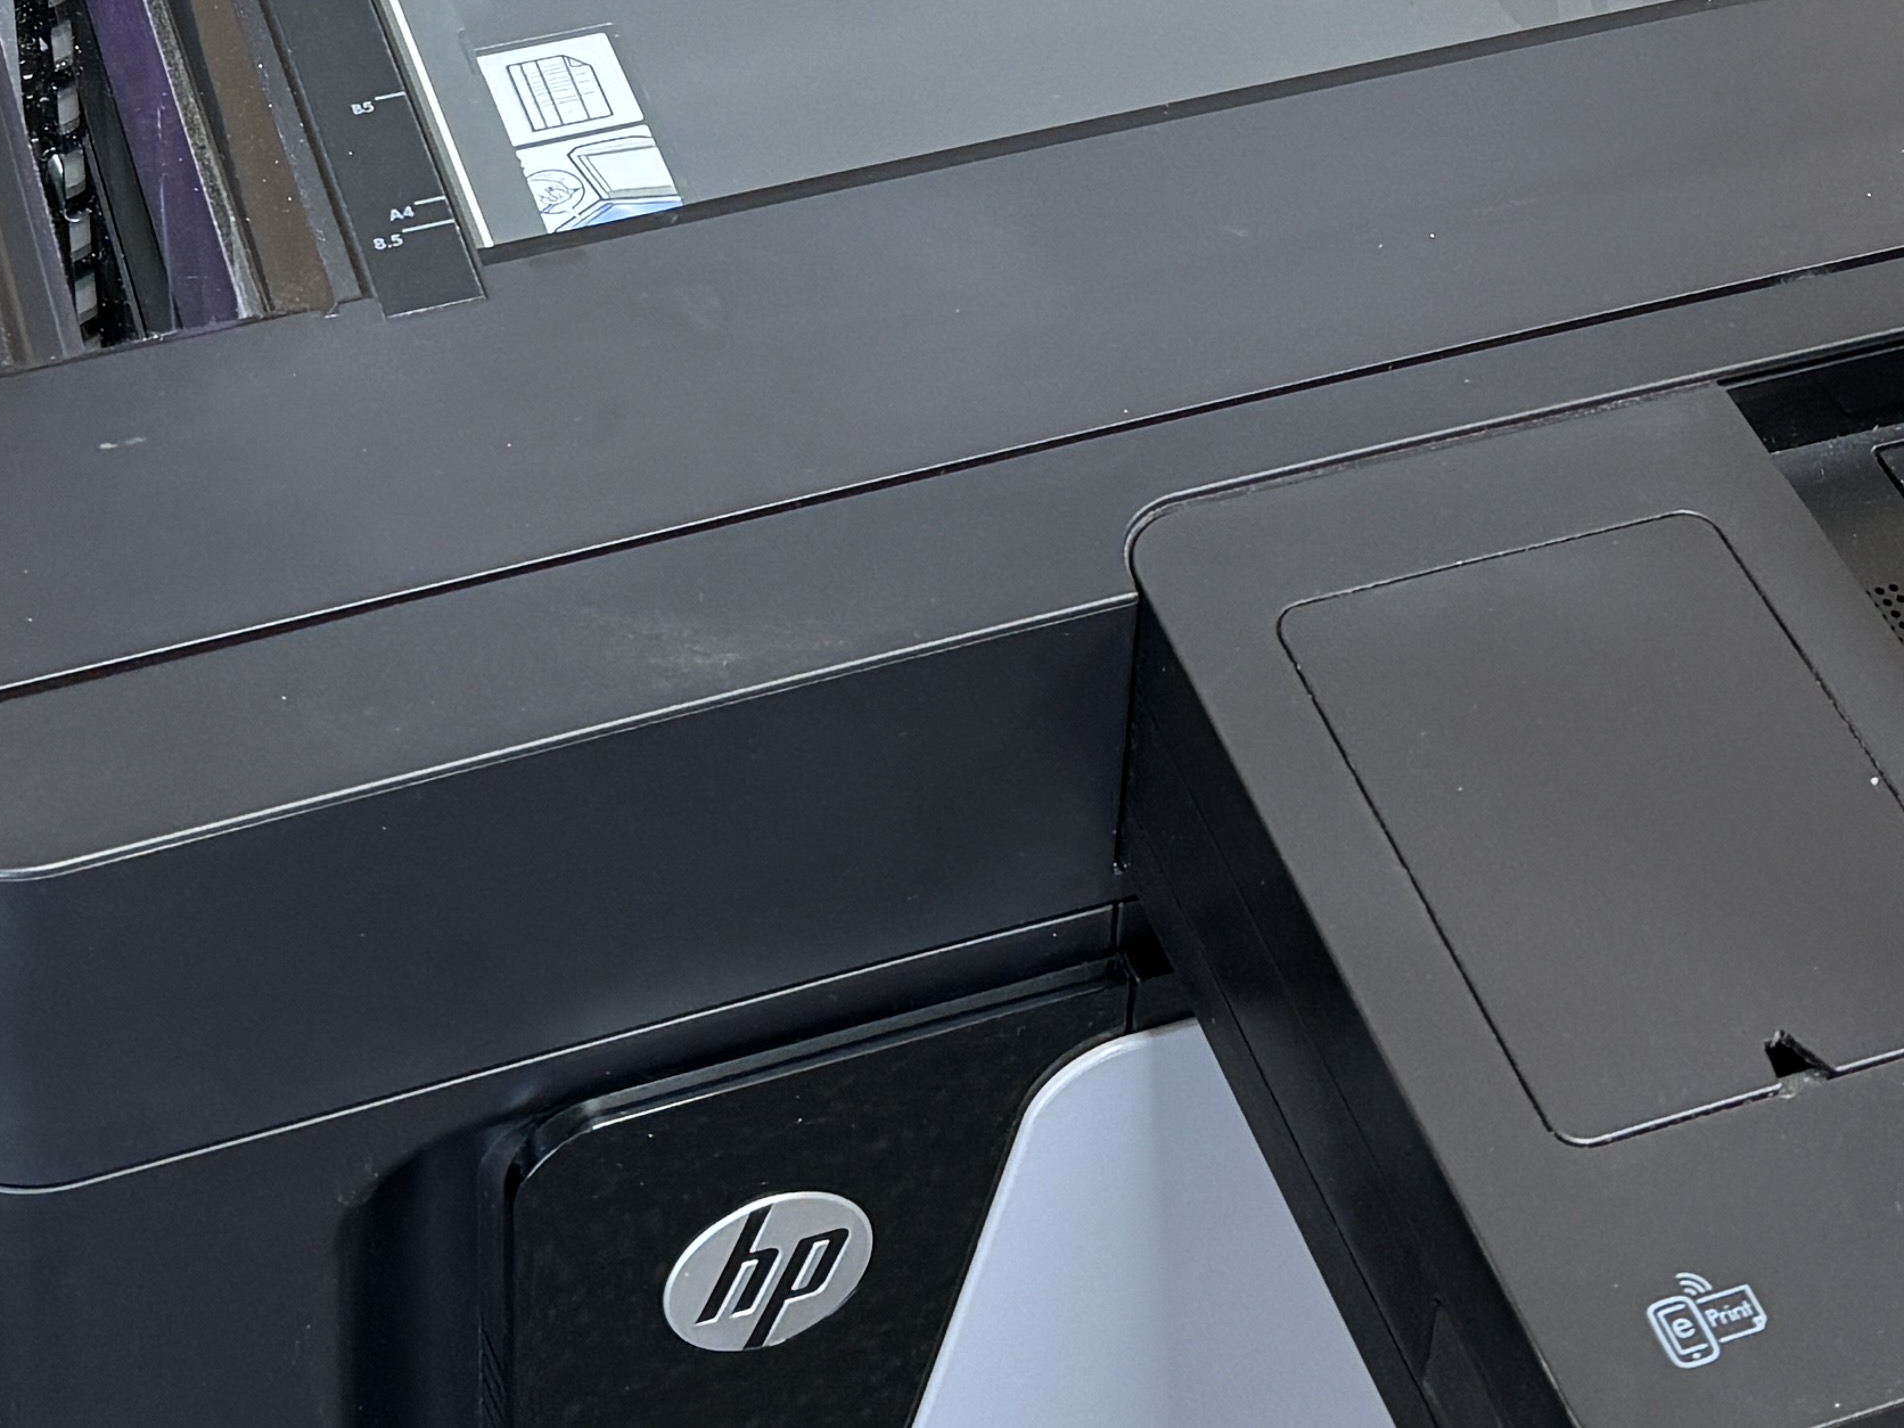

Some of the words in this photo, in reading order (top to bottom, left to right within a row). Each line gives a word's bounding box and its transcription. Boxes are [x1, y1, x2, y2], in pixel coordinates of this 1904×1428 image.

[350, 100, 376, 116] B5
[389, 205, 415, 222] A4
[372, 233, 404, 250] 8.5
[693, 1201, 851, 1350] hp
[1704, 1299, 1756, 1328] Print
